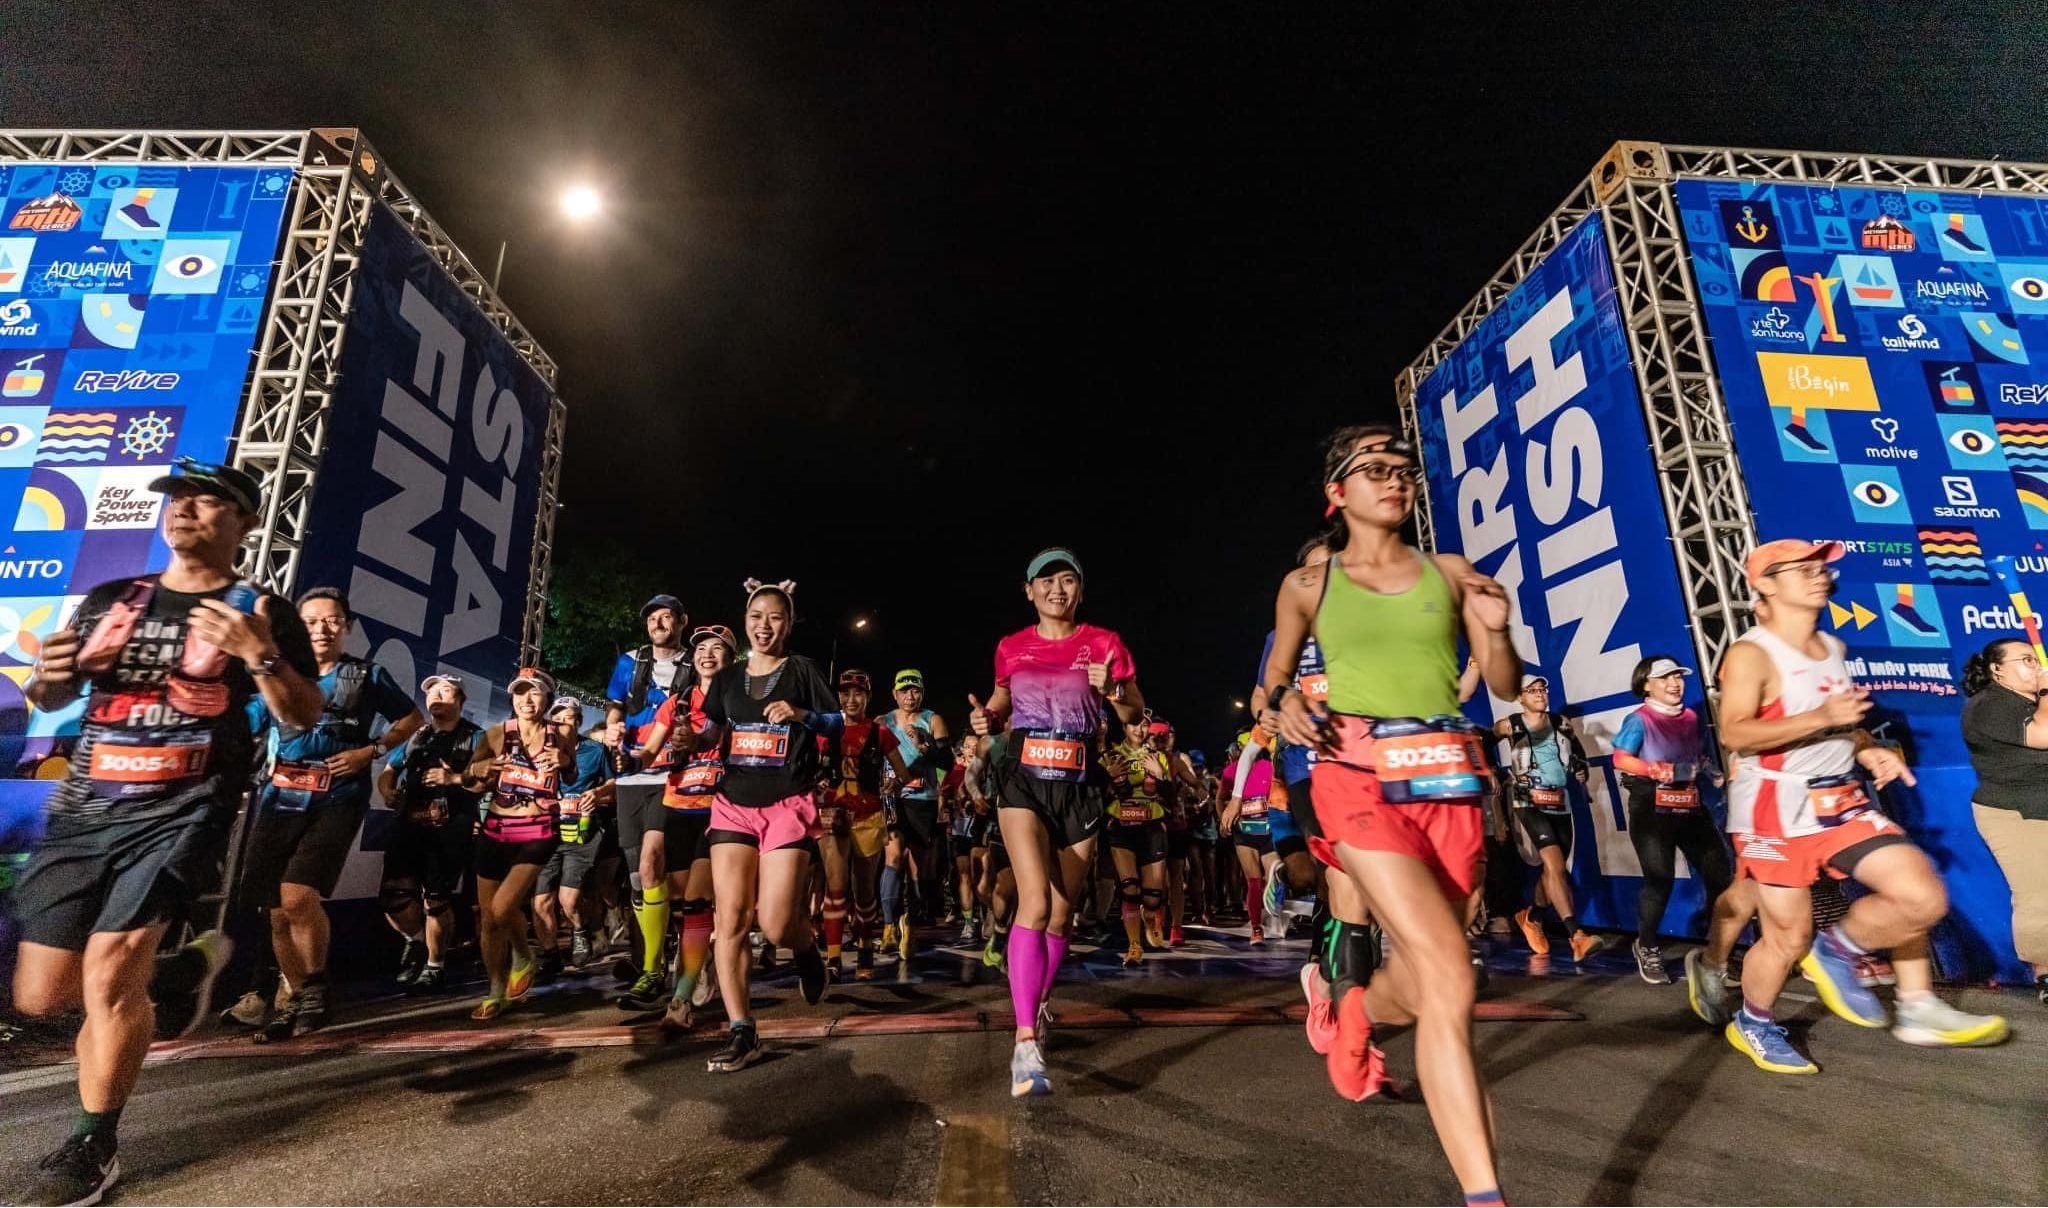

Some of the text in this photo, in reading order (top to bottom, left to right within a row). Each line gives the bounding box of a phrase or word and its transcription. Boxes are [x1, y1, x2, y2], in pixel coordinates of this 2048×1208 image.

[44, 260, 133, 281] AQUAFINA
[1917, 279, 1990, 300] AQUAFINA
[1881, 335, 1941, 350] tailwind
[74, 369, 180, 393] ReVive
[1865, 447, 1919, 460] motive
[99, 486, 135, 501] Key
[96, 498, 157, 511] Power
[92, 510, 152, 526] Sports
[1933, 506, 2001, 519] salomon
[1882, 558, 1901, 567] ASIA
[1505, 285, 1692, 878] FINISH
[735, 737, 772, 750] 30036
[1027, 745, 1073, 761] 30087
[1384, 744, 1466, 769] 30265
[97, 754, 179, 772] 30054
[1661, 793, 1692, 803] 30257
